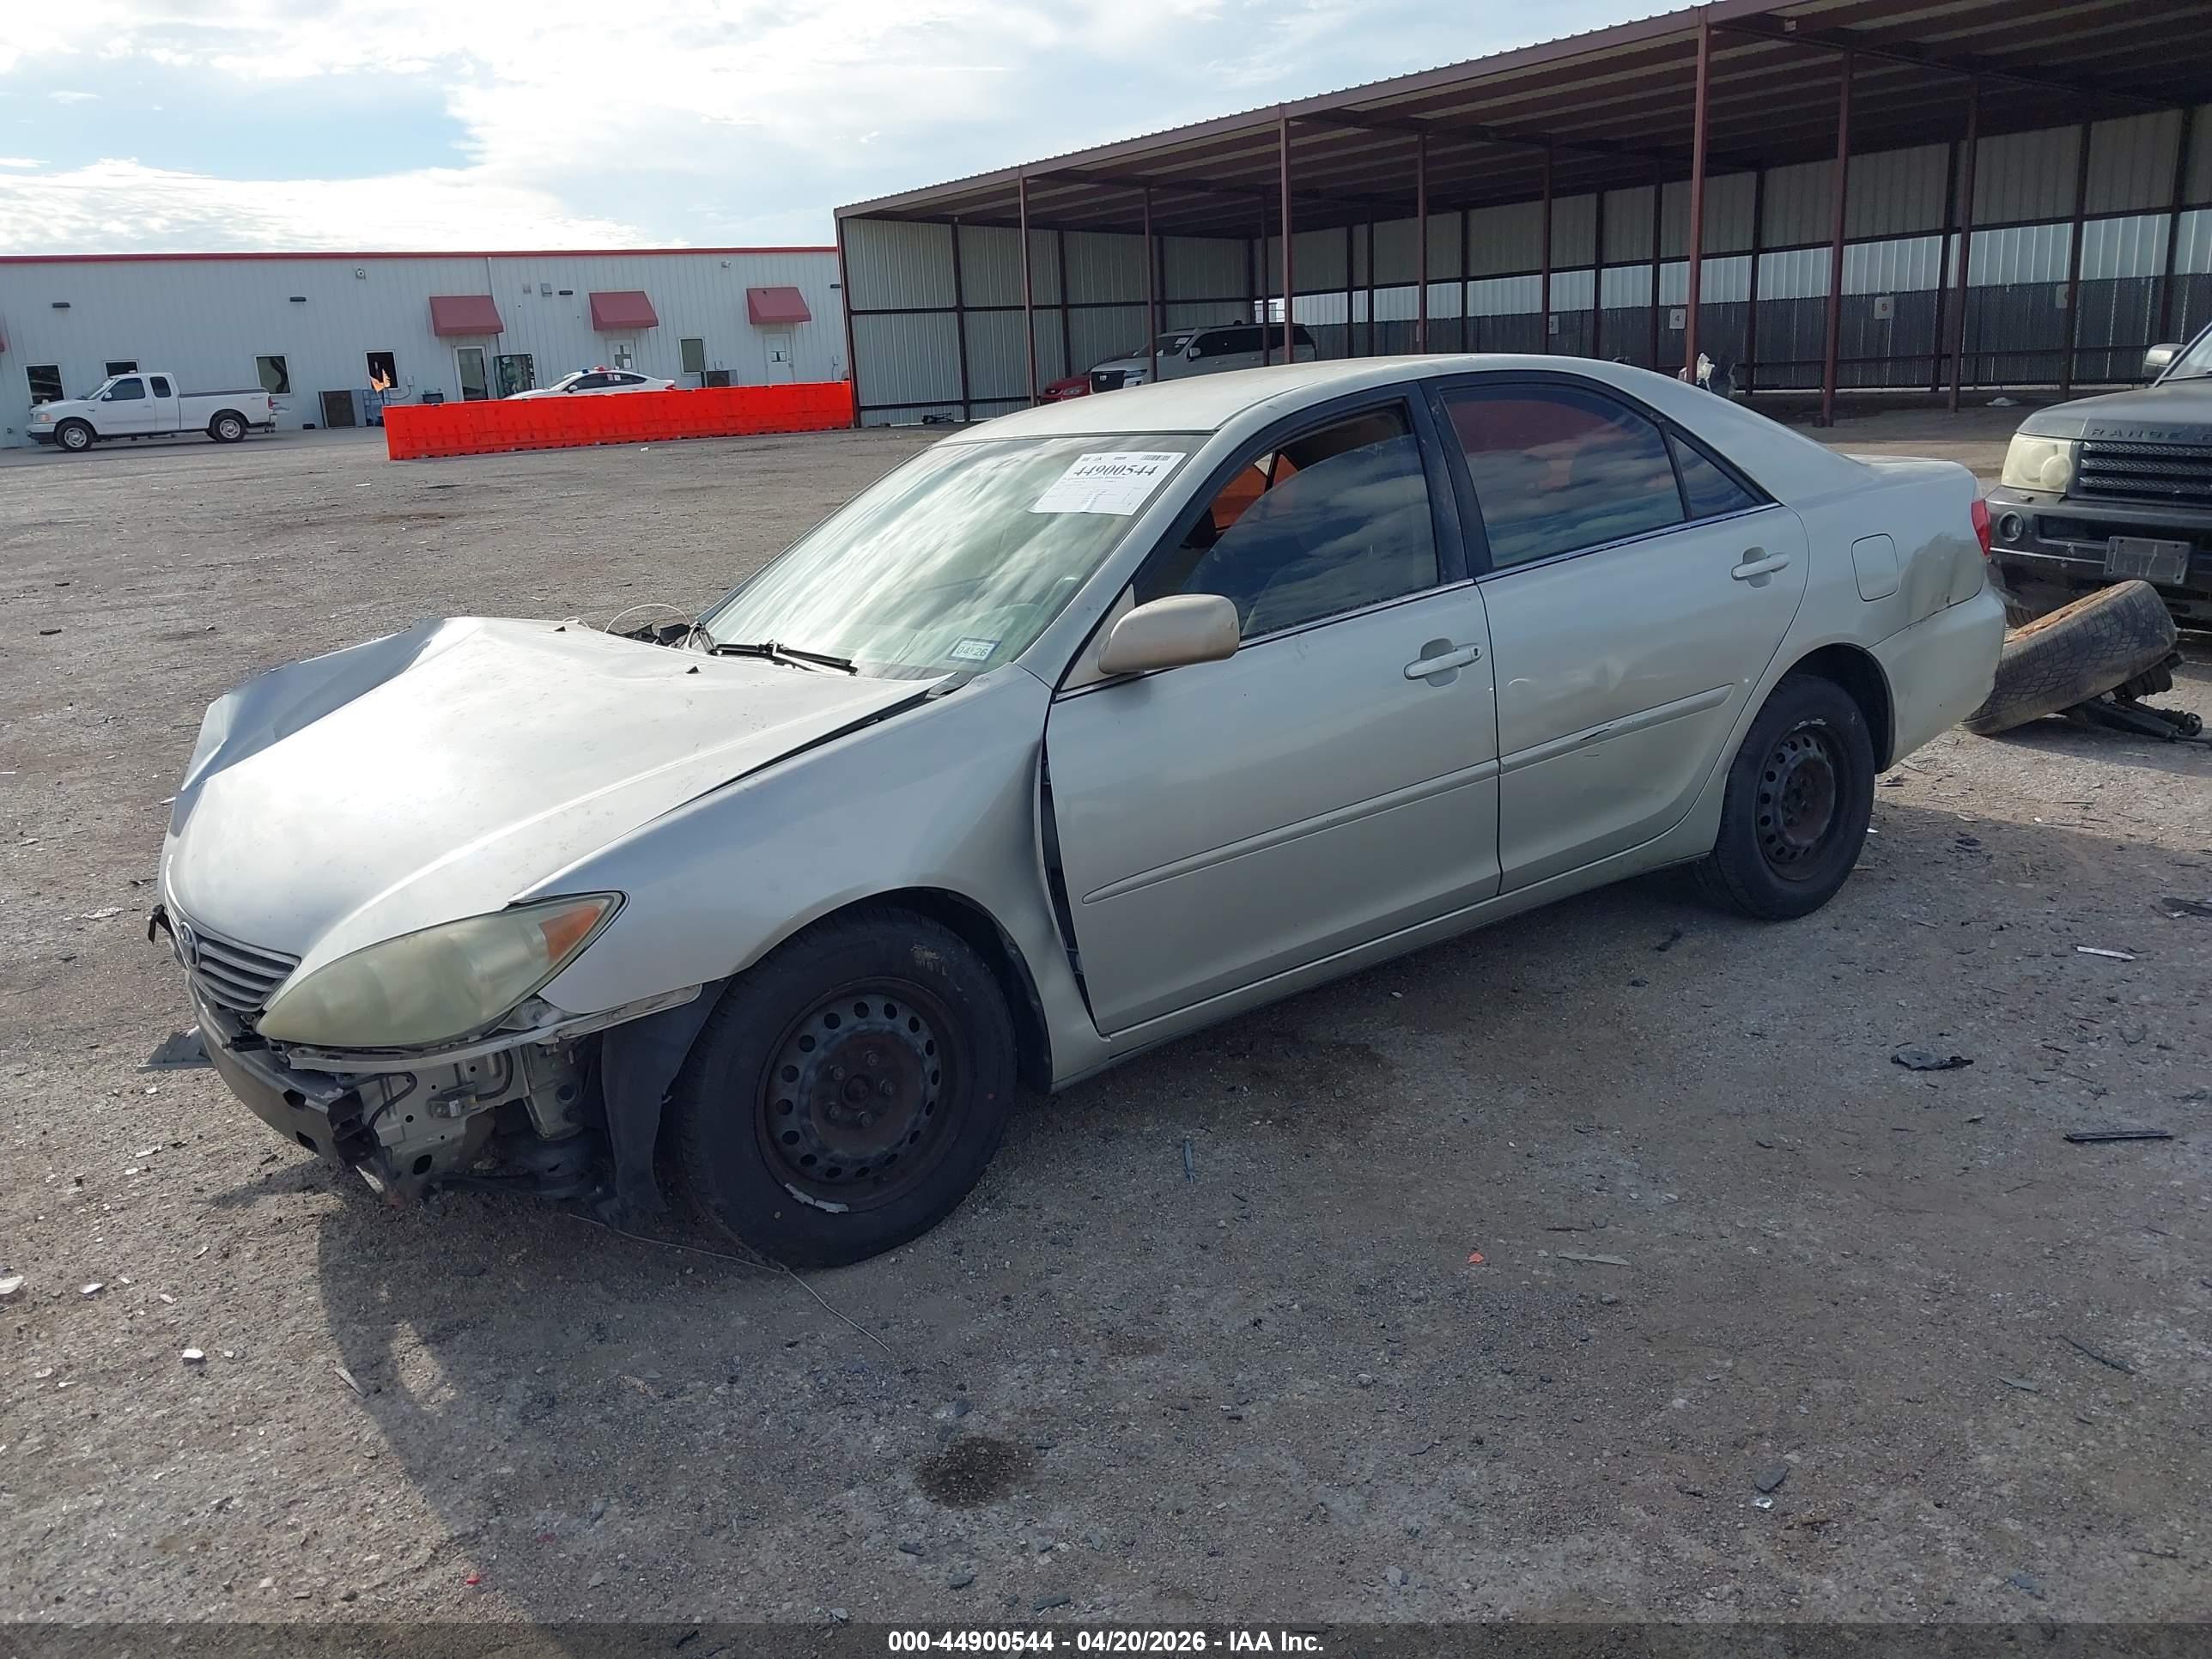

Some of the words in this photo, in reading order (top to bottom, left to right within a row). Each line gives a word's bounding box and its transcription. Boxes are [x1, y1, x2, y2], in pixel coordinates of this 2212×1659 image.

[2091, 428, 2182, 440] RANGE
[1073, 465, 1159, 477] 44900544
[973, 647, 989, 657] 26
